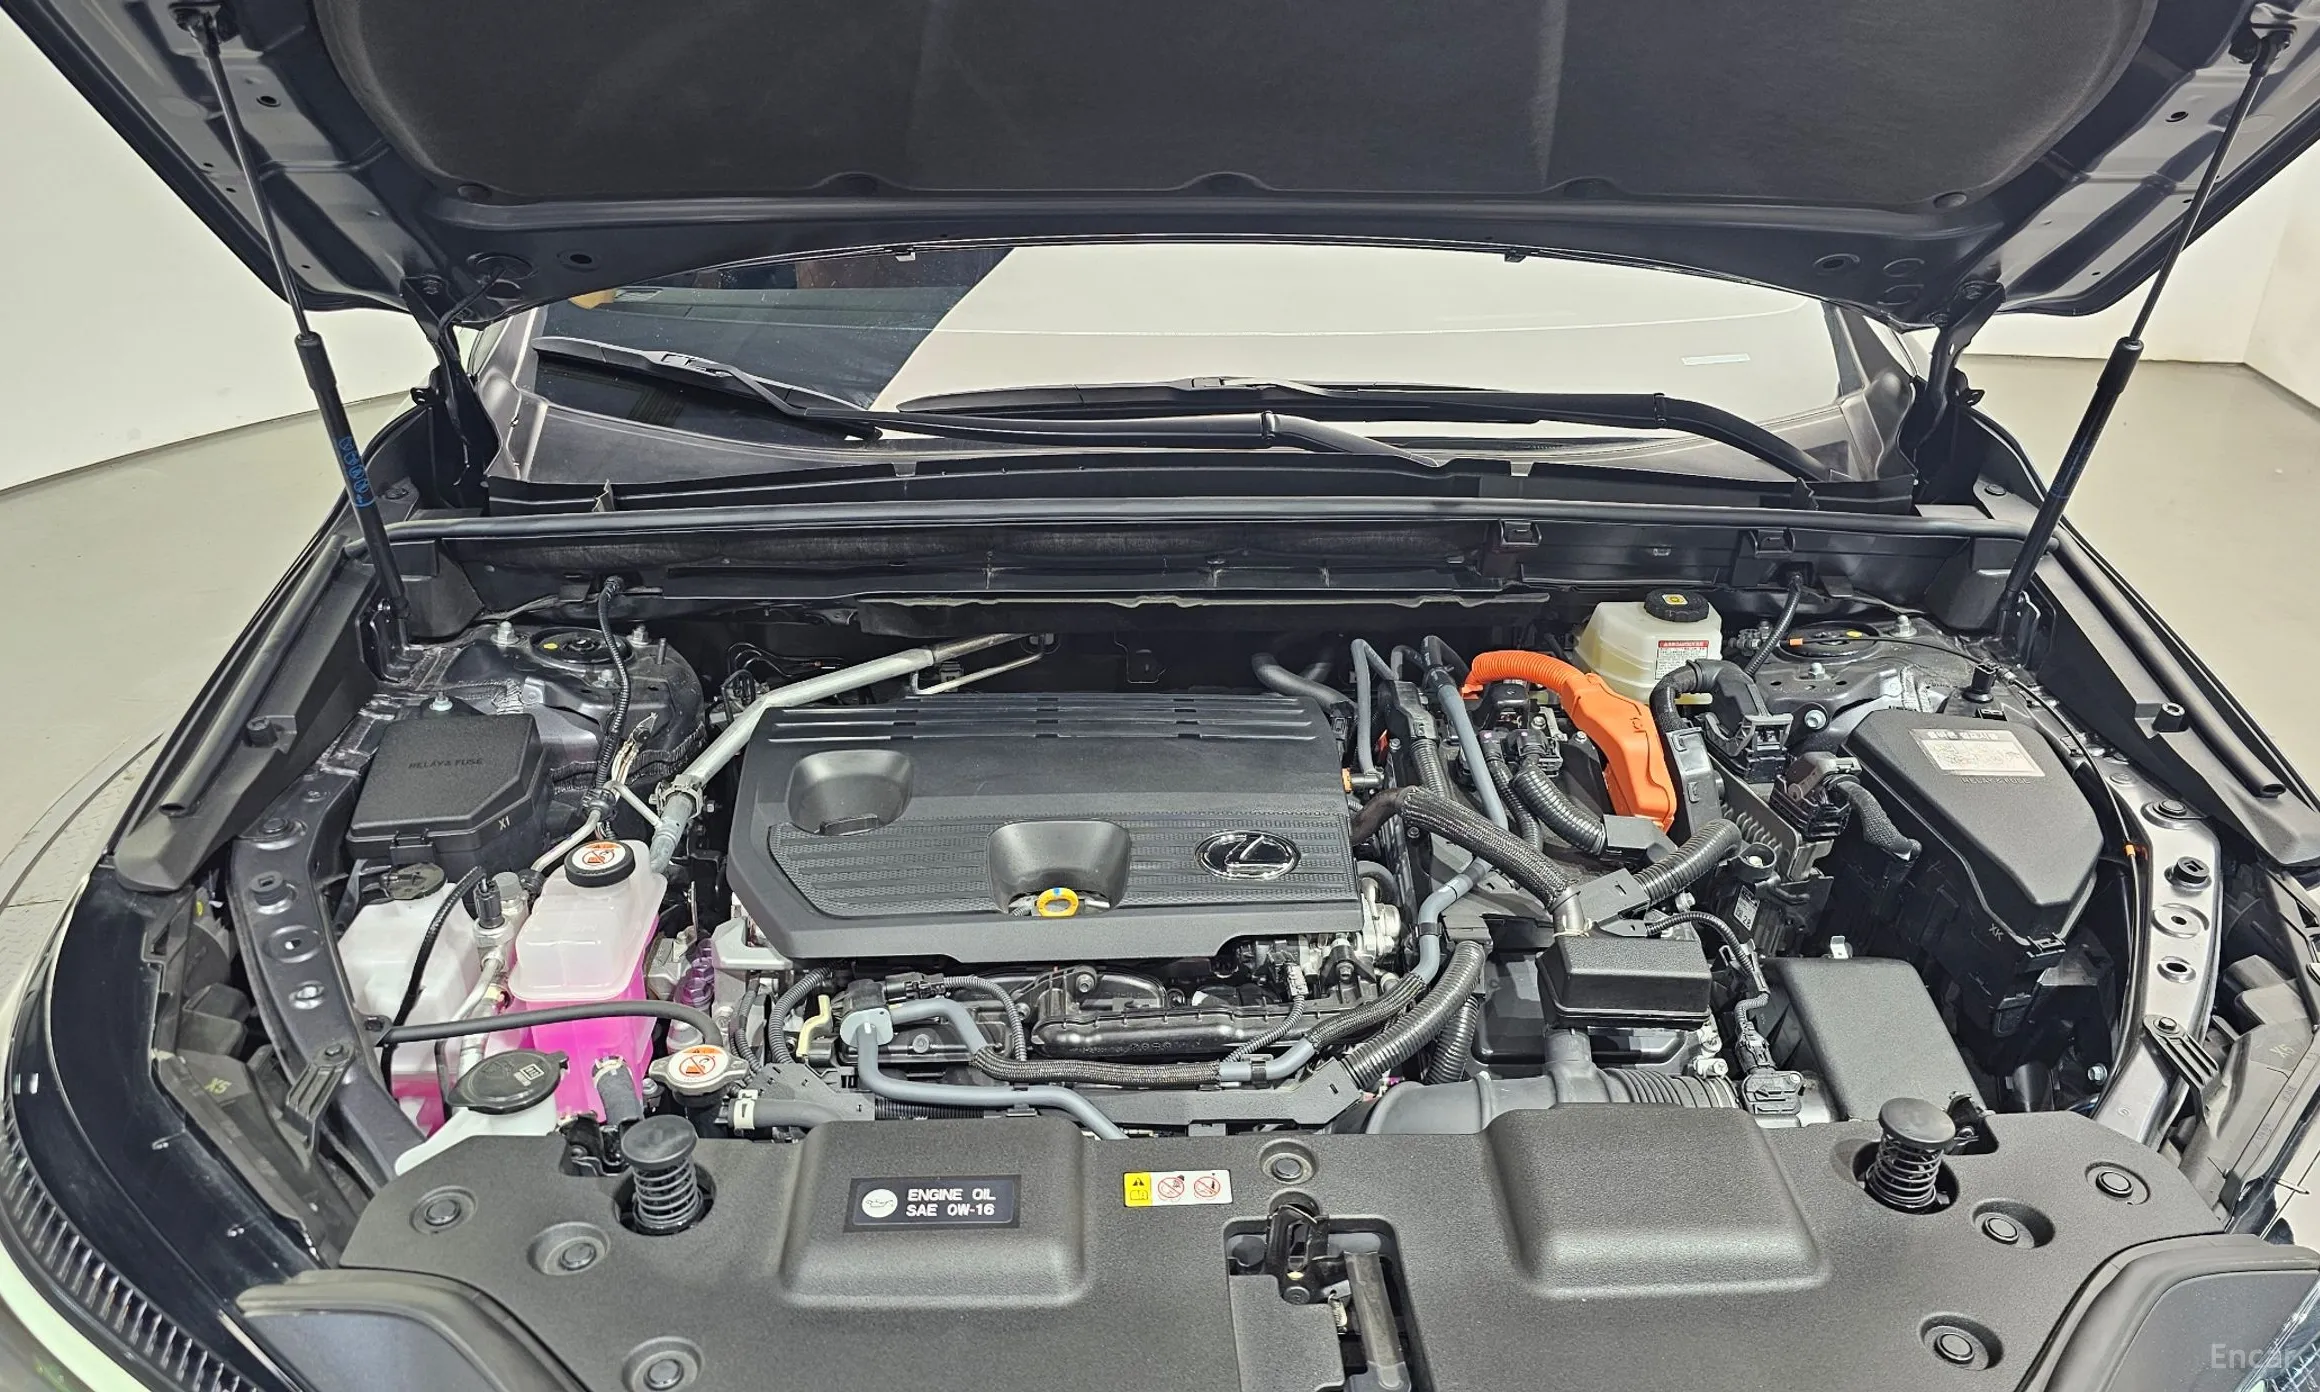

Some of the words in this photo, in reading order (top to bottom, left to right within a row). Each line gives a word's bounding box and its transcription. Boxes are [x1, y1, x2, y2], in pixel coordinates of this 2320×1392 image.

[907, 1188, 963, 1201] ENGINE
[971, 1188, 997, 1201] OIL
[905, 1203, 939, 1217] SAE
[947, 1203, 996, 1217] 0W-16
